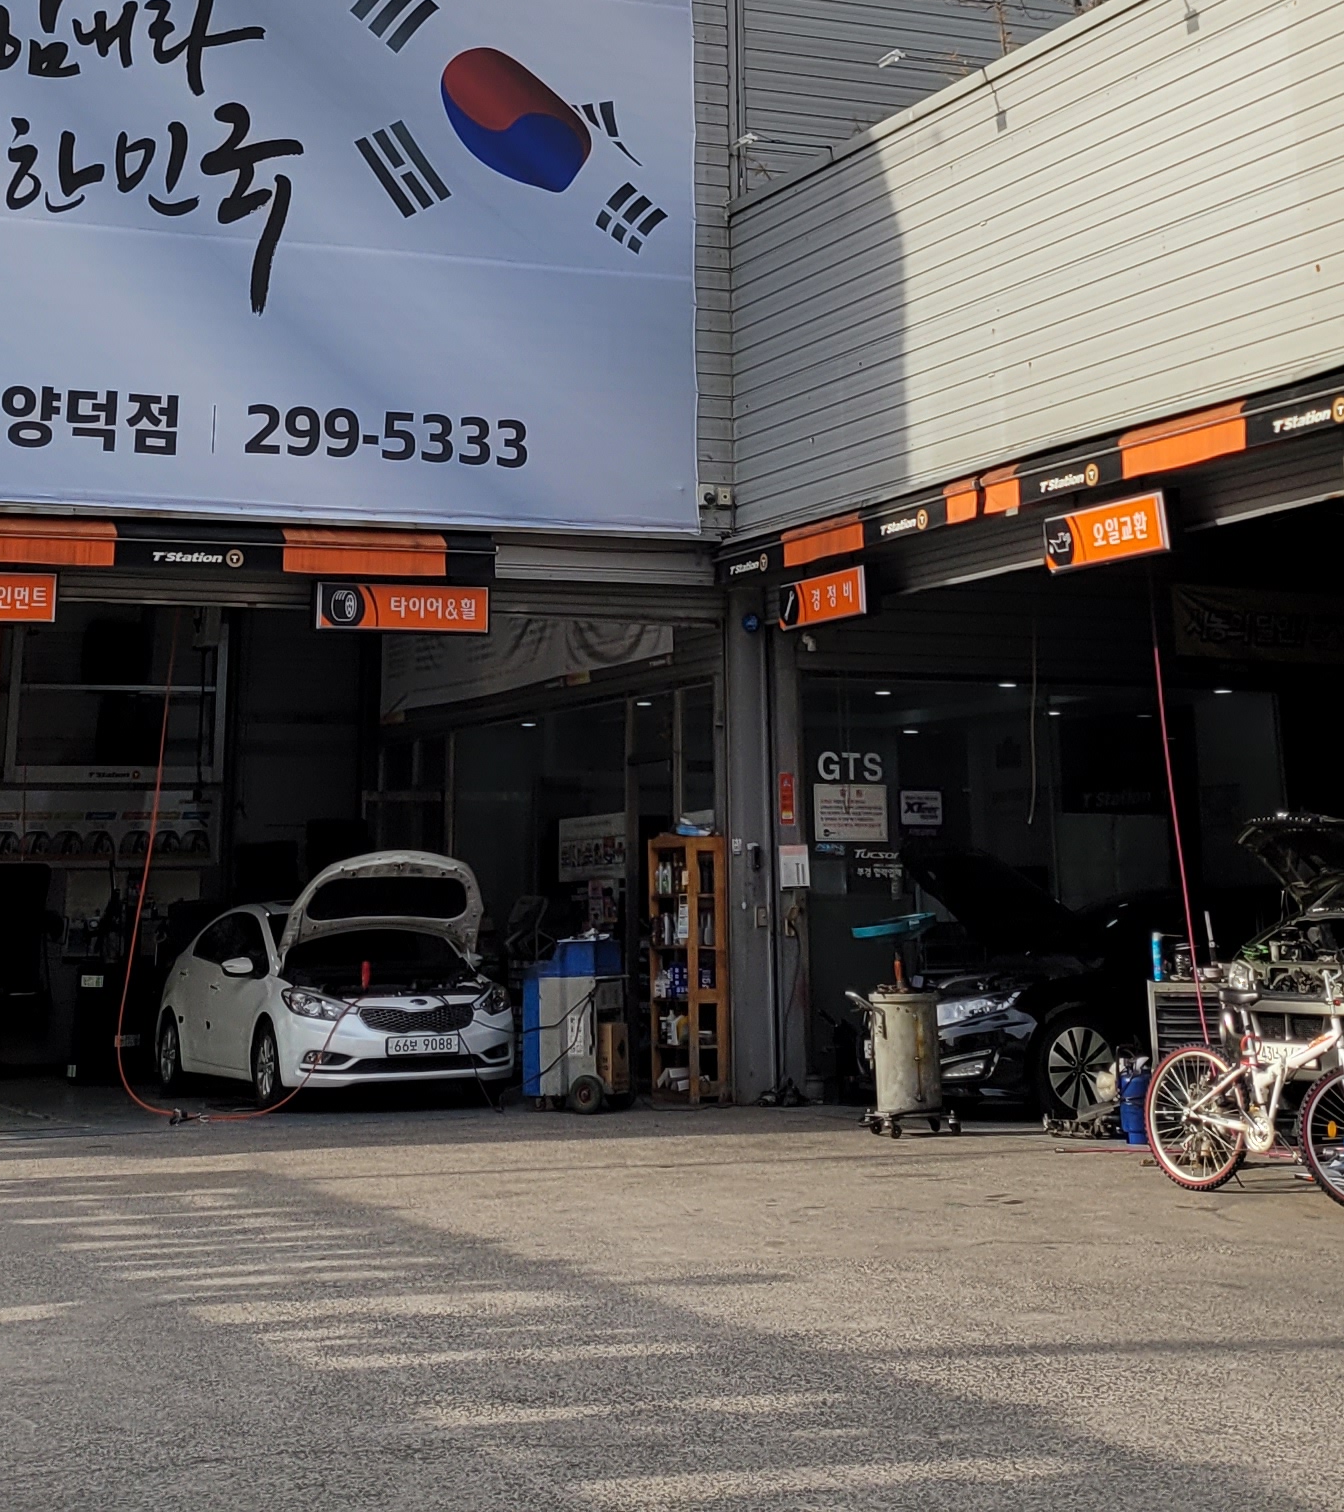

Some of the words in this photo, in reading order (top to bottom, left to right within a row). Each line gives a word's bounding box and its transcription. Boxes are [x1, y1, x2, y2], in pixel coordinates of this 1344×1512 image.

[0, 385, 180, 457] 양덕점
[244, 402, 530, 469] 299-5333
[1092, 510, 1148, 548] 오일교환
[390, 596, 476, 621] 타이어&휠
[811, 580, 853, 612] 경정비
[816, 751, 884, 782] GTS
[394, 1038, 419, 1053] 66보
[422, 1037, 453, 1052] 9088
